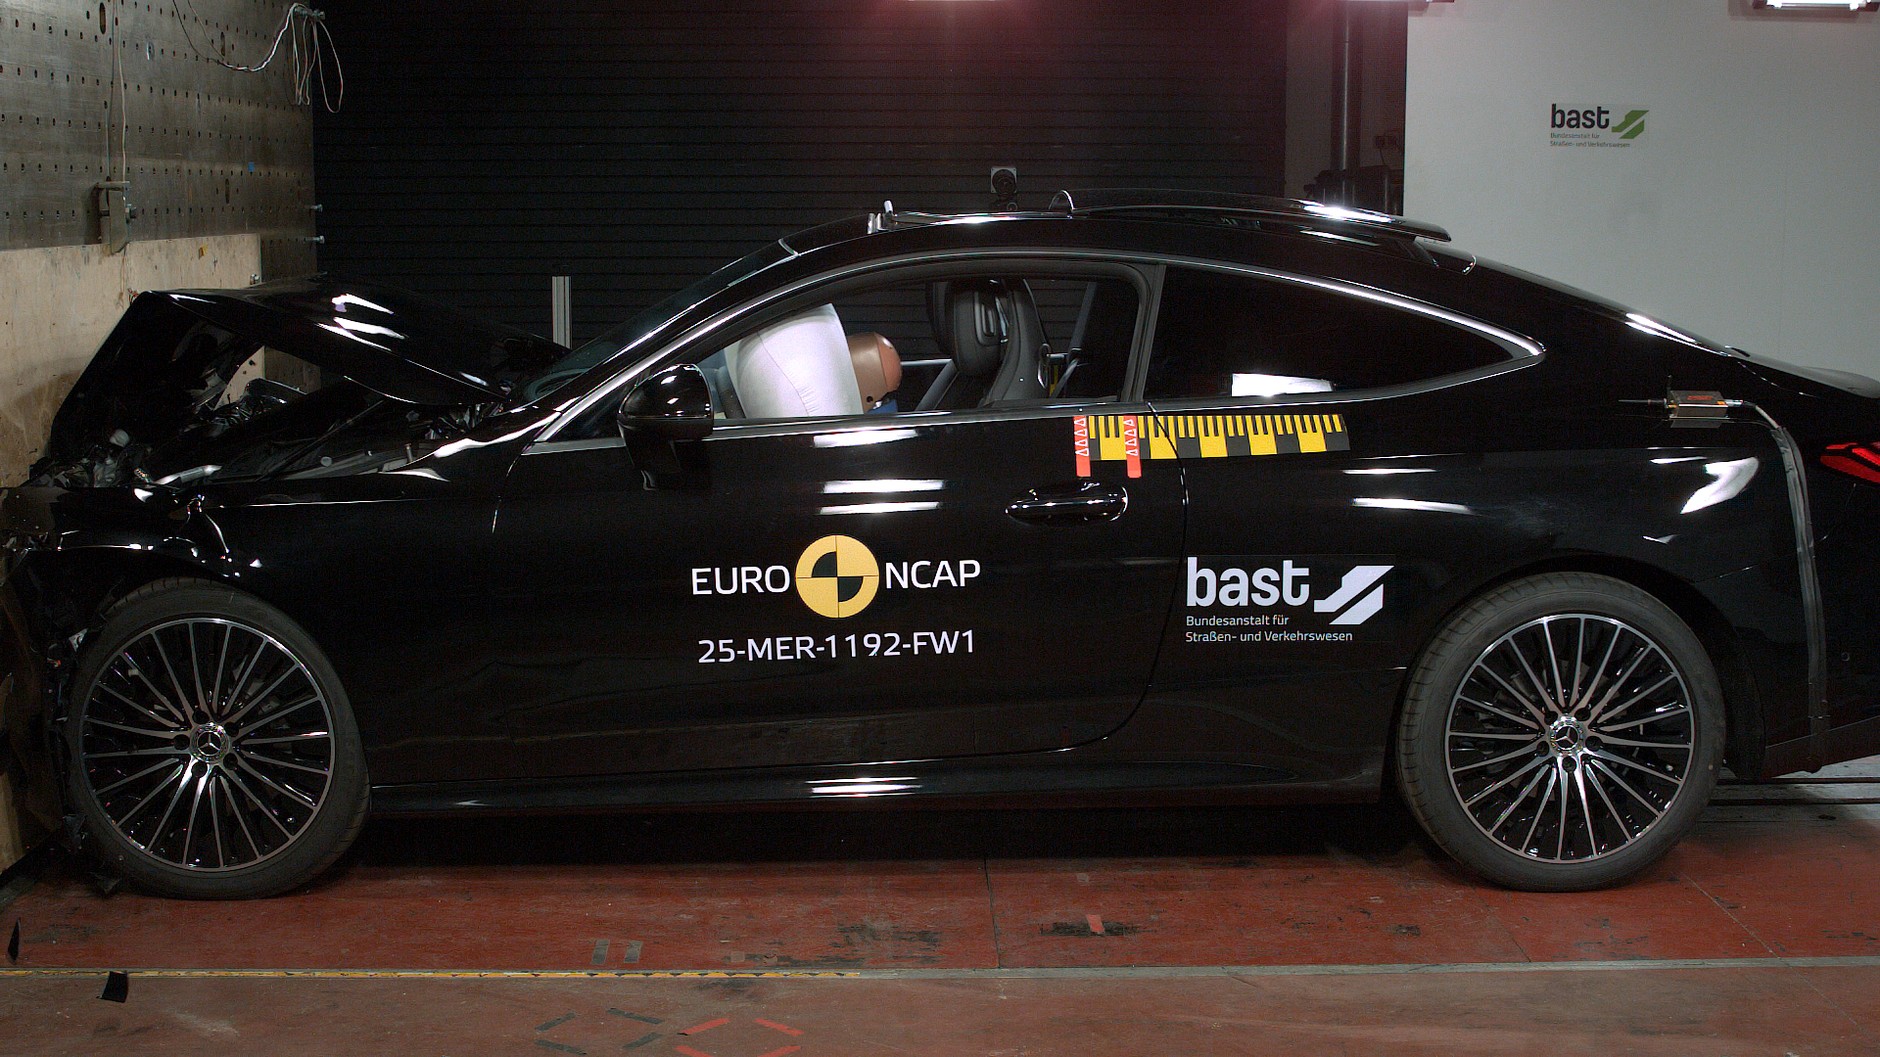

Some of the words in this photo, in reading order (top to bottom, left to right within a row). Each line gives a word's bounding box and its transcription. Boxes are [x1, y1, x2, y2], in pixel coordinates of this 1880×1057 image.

[1551, 103, 1610, 129] bast
[691, 564, 791, 595] EURO
[885, 559, 982, 589] NCAP
[1186, 556, 1310, 607] bast
[1186, 615, 1270, 627] Bundesanstalt
[1272, 614, 1289, 626] für
[698, 629, 974, 664] 25-MER-1192-FW1
[1185, 631, 1237, 643] Straßen-
[1240, 631, 1262, 642] und
[1264, 630, 1353, 642] Verkehrswesen
